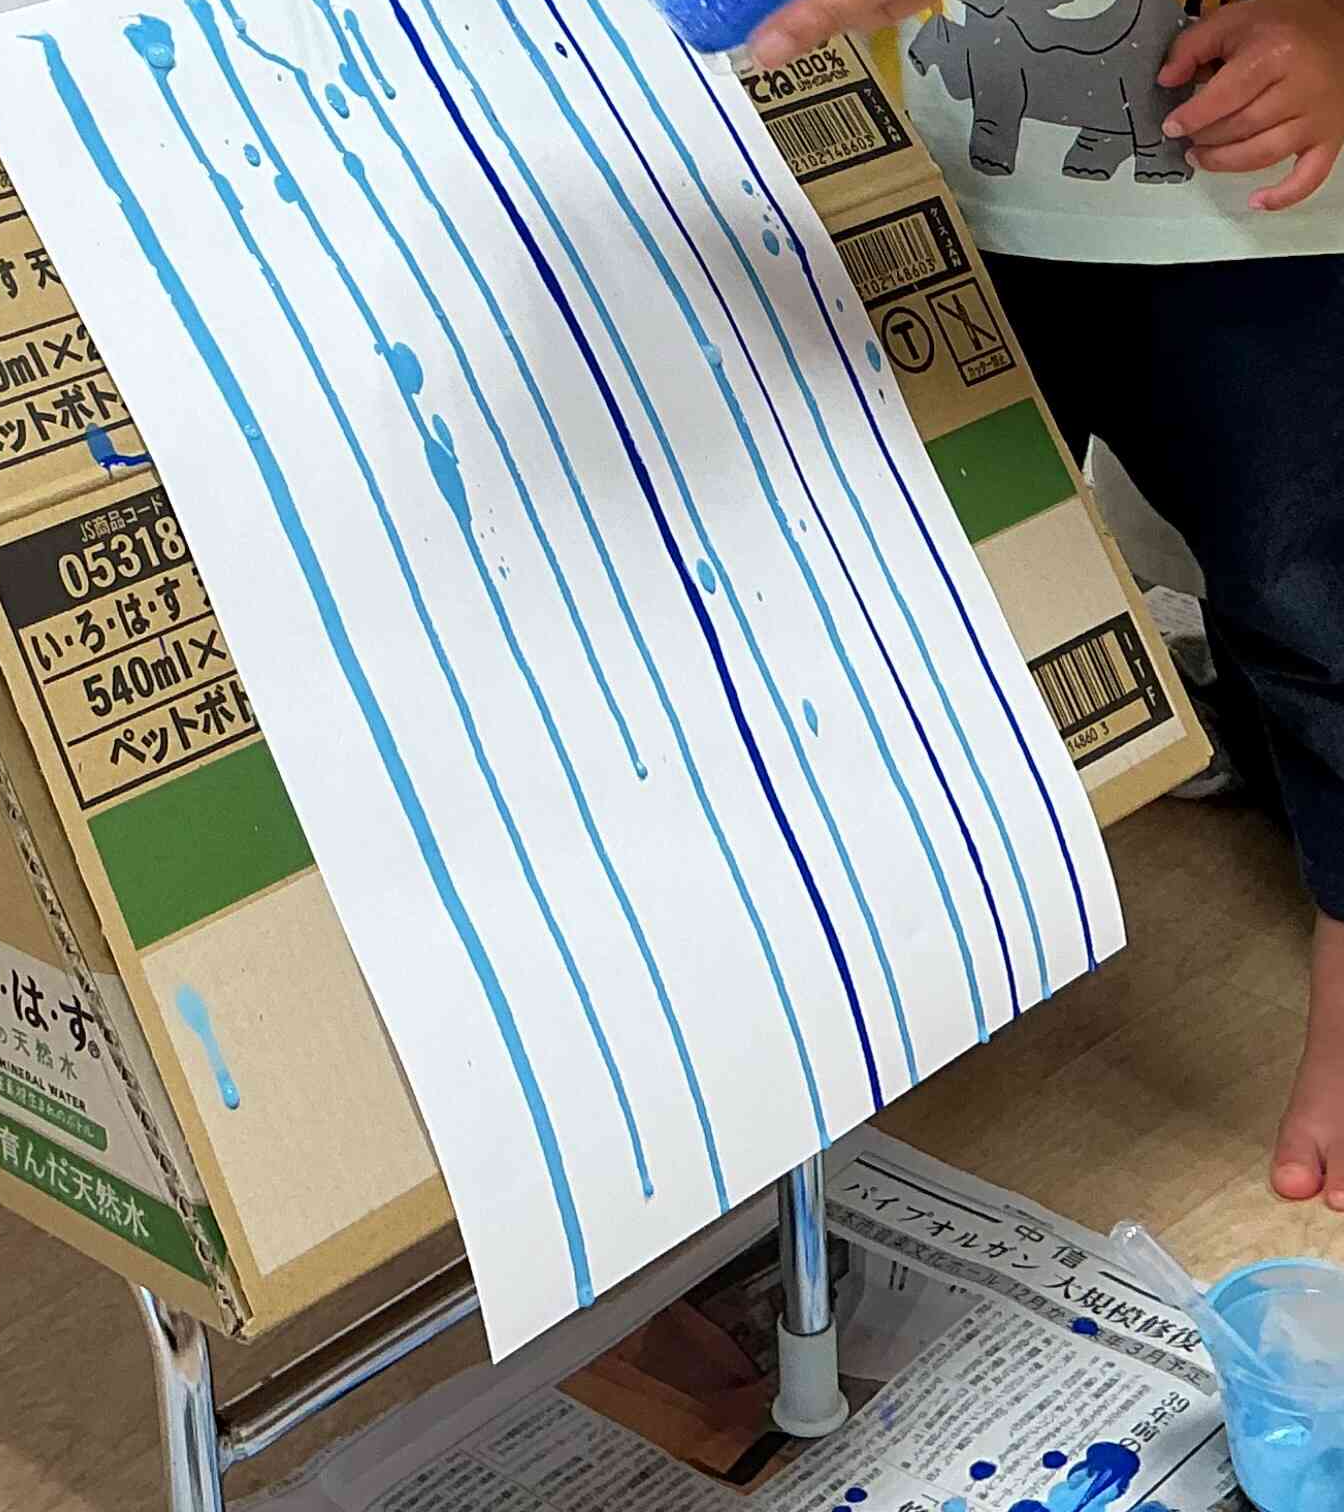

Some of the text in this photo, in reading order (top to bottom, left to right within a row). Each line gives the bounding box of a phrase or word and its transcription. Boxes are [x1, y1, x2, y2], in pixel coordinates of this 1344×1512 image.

[80, 494, 165, 543] JS商品コード
[48, 1082, 87, 1113] WATER
